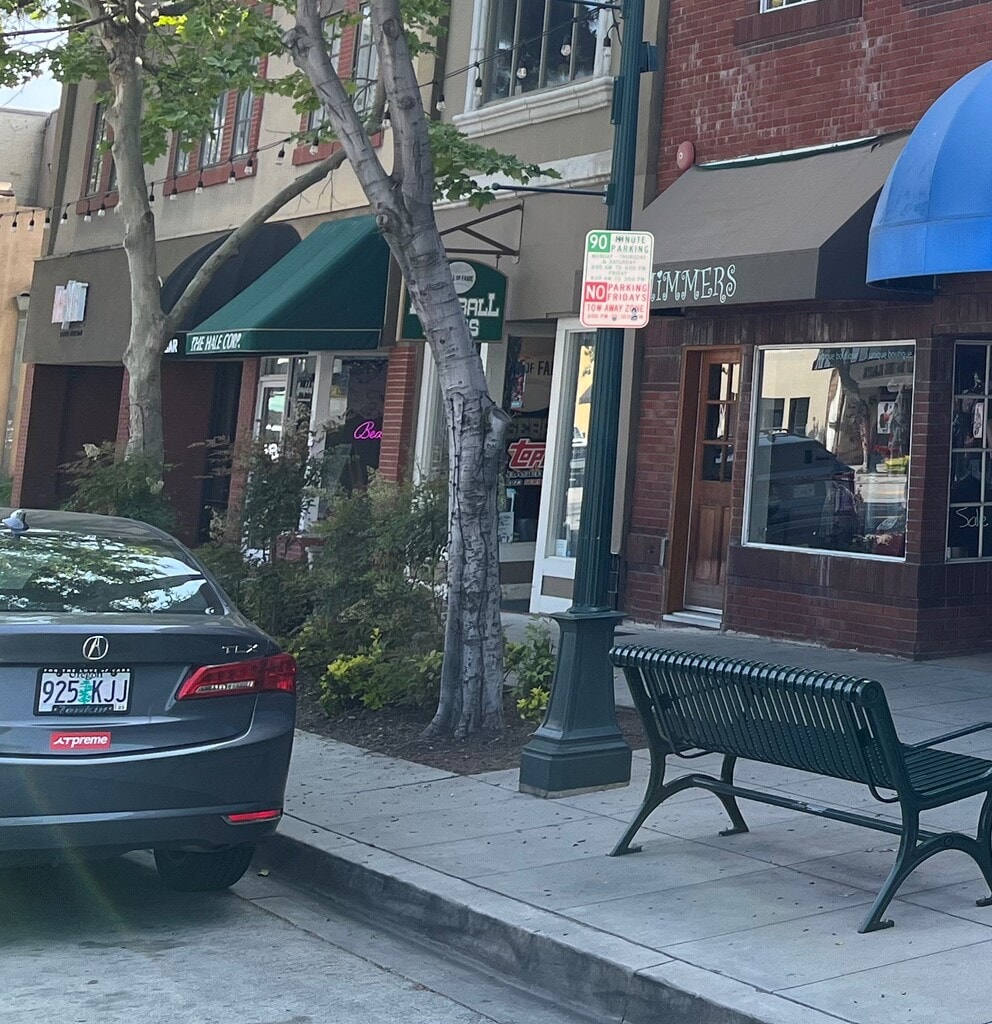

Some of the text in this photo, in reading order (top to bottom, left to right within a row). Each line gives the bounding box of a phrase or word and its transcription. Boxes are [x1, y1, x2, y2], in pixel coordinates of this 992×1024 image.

[589, 234, 608, 250] 90
[615, 236, 646, 244] MINUTE
[611, 245, 649, 254] PARKING
[586, 284, 606, 301] NO
[608, 283, 647, 292] PARKING
[607, 293, 647, 302] FRIDAYS
[587, 304, 645, 313] TOW AWAY ZONE
[190, 336, 205, 351] THE
[956, 507, 989, 528] Sale
[221, 644, 258, 654] TLX
[42, 680, 128, 704] 925 KJJ
